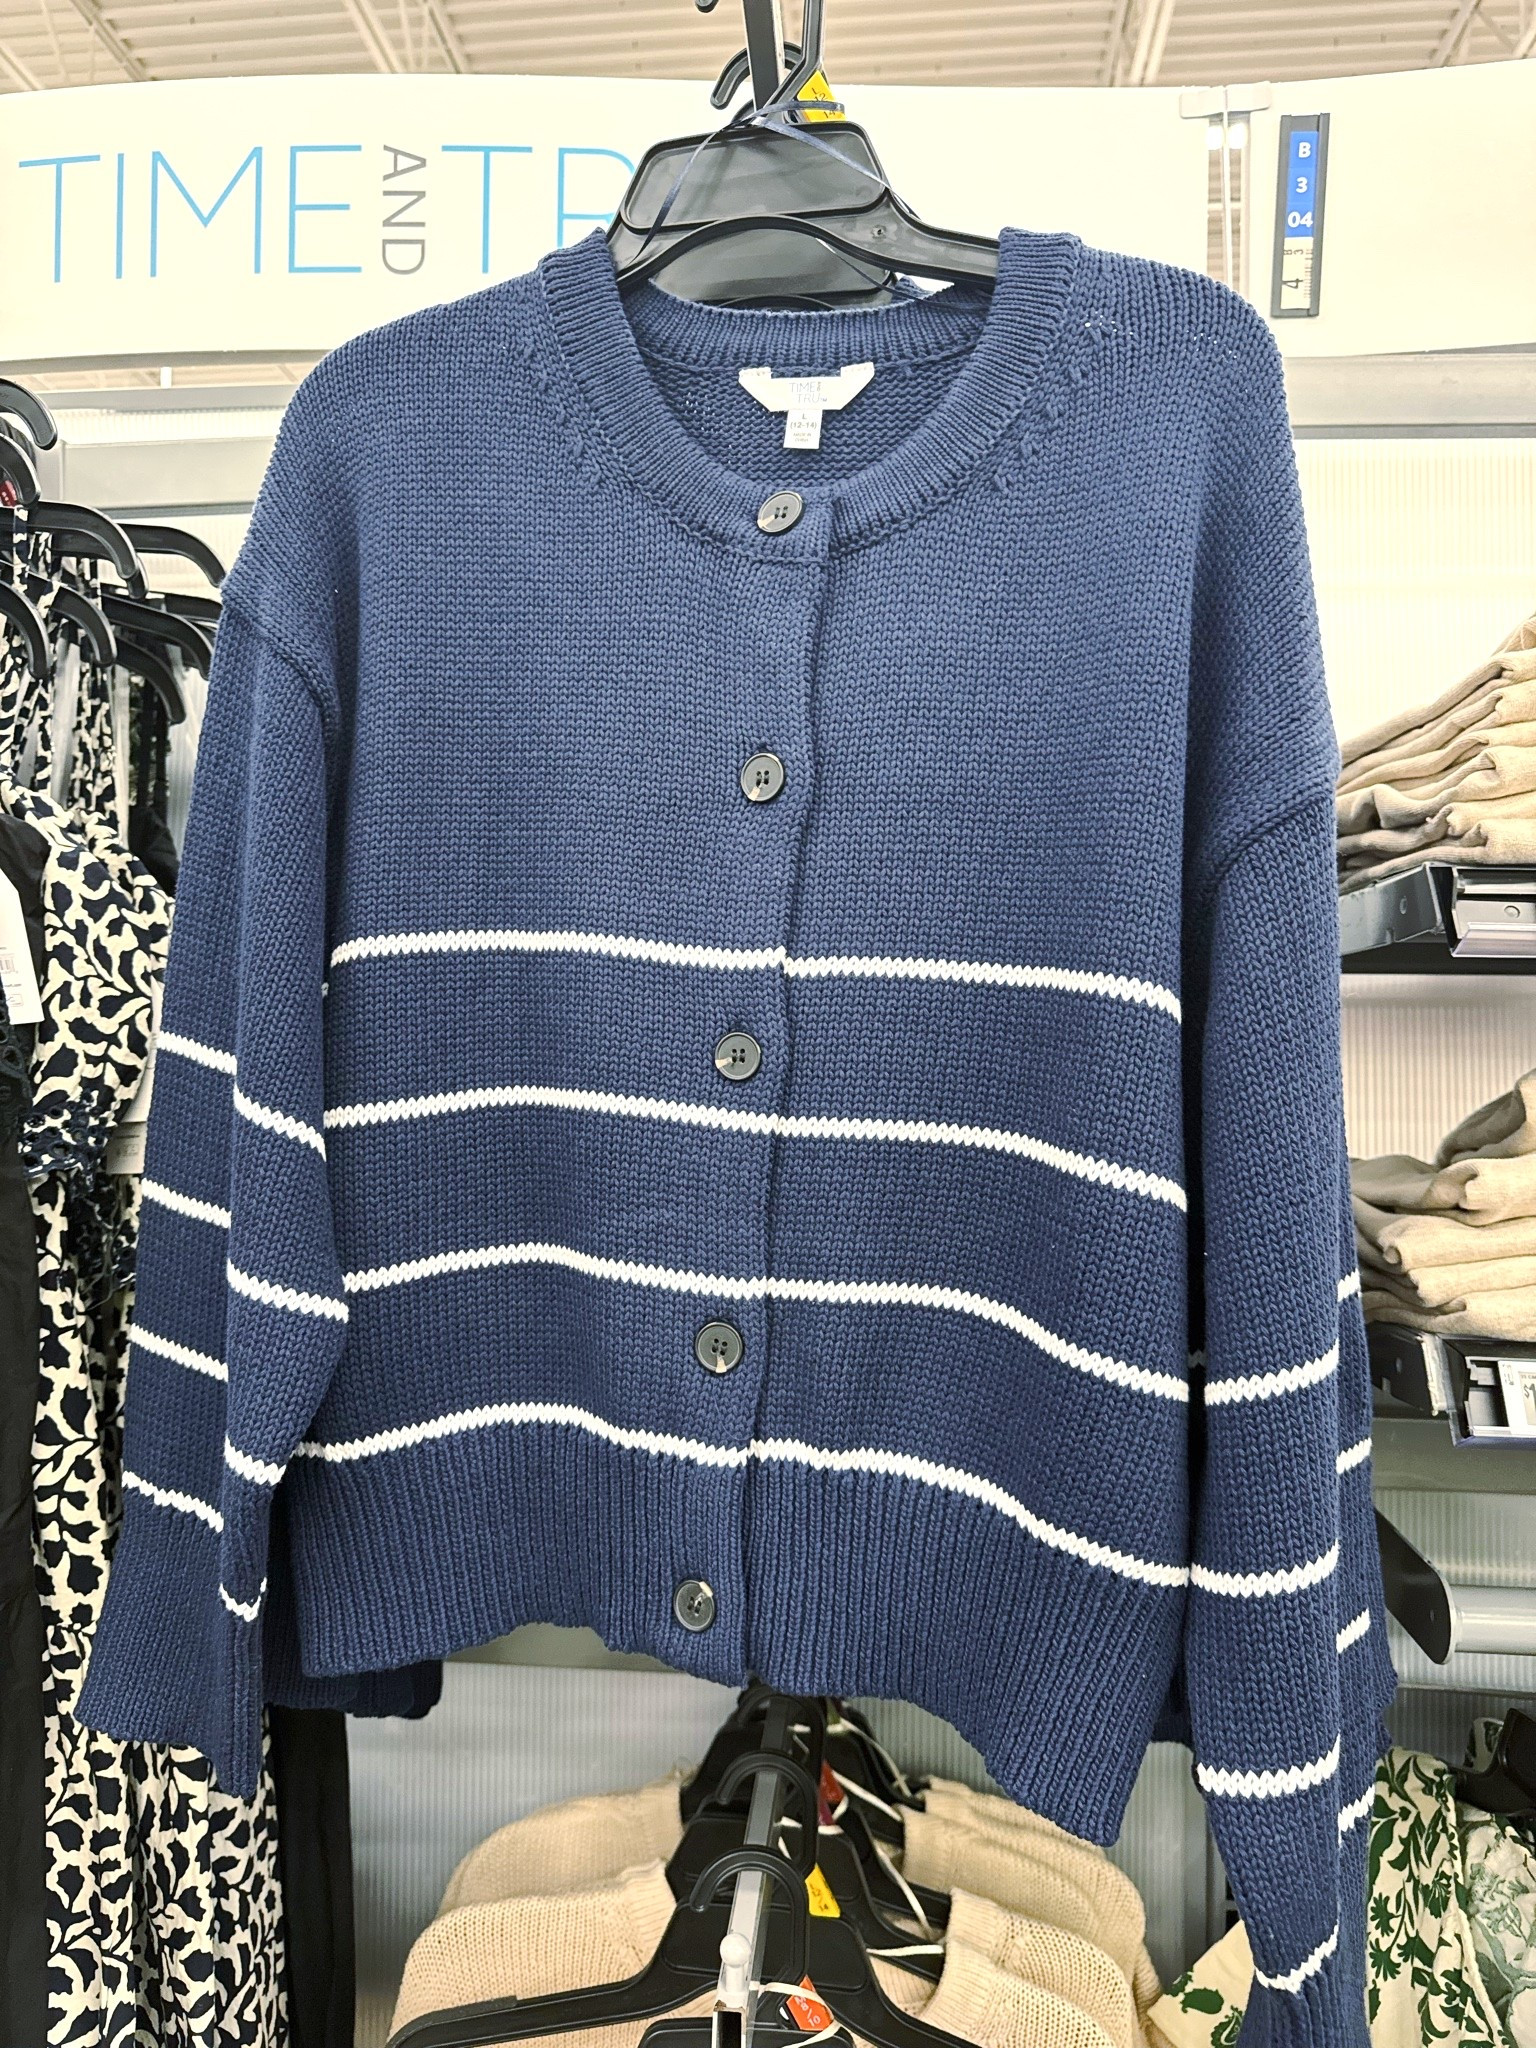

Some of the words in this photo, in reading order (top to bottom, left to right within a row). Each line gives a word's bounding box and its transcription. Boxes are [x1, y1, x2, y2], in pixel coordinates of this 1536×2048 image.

[1298, 142, 1312, 158] B
[1296, 177, 1308, 193] 3
[19, 145, 362, 283] TIME
[381, 144, 426, 275] AND
[441, 145, 636, 274] TR
[1287, 211, 1314, 228] 04
[789, 381, 816, 393] TIME
[790, 421, 818, 430] (12-14)
[808, 2015, 821, 2027] 10
